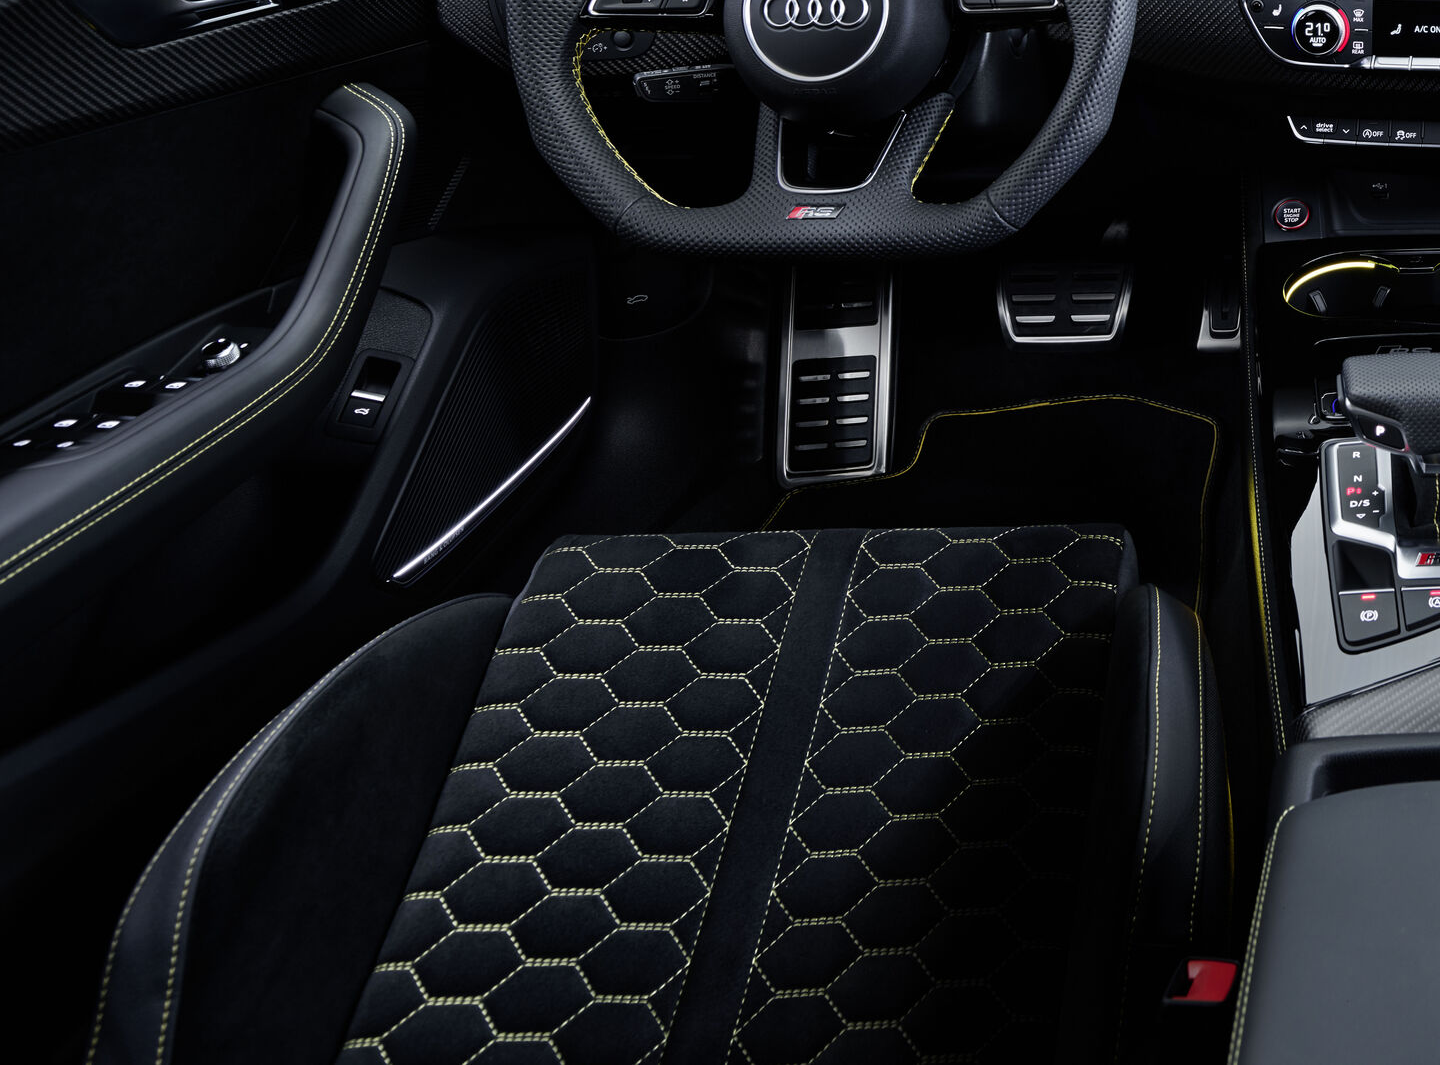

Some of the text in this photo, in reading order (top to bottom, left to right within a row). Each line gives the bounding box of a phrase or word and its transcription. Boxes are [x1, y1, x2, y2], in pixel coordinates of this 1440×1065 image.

[1414, 25, 1429, 33] A/C
[1375, 425, 1386, 436] P
[1352, 451, 1361, 459] R
[1353, 474, 1363, 483] N
[1349, 499, 1371, 508] D/S
